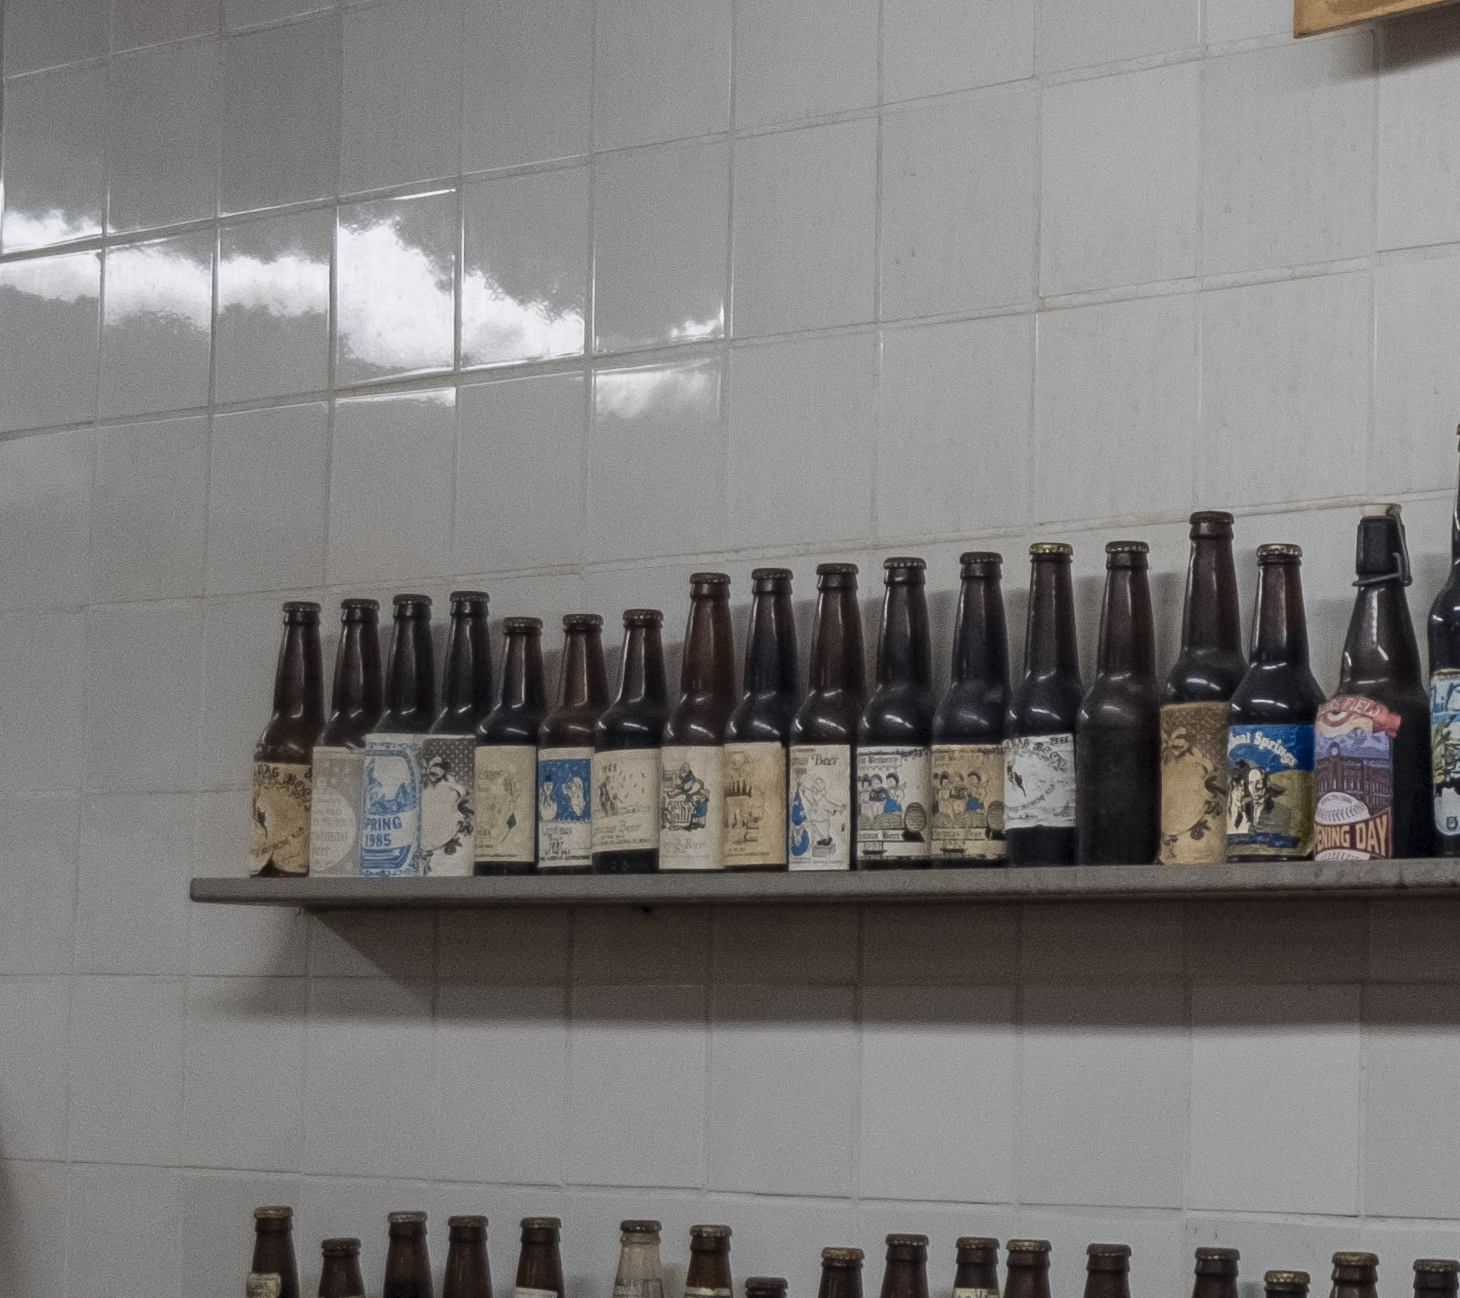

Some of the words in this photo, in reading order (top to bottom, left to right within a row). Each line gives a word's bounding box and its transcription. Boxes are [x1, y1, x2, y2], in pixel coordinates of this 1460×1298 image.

[363, 833, 393, 849] 1985
[1316, 824, 1351, 852] ENING
[1355, 813, 1389, 859] DAY
